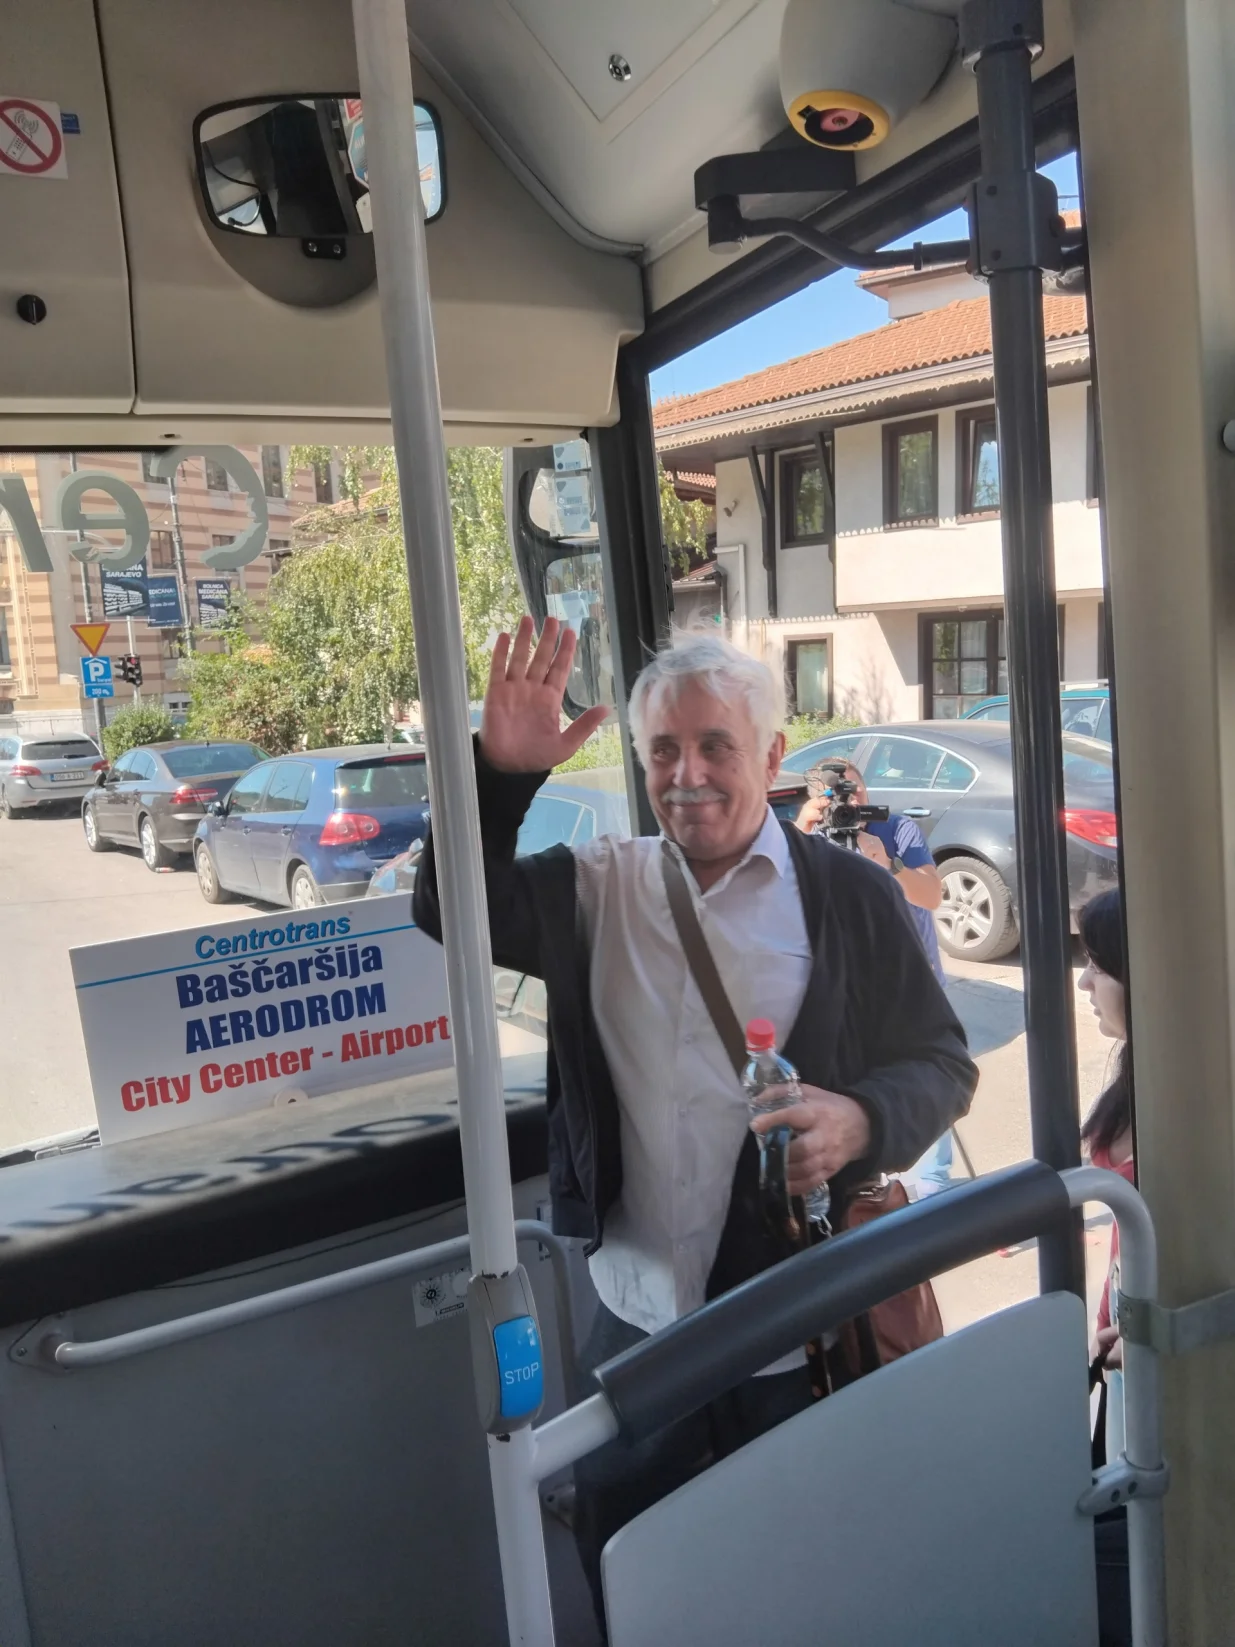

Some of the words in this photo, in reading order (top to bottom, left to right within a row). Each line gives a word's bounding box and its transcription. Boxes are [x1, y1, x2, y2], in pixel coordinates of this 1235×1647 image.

[89, 662, 104, 682] P
[195, 915, 351, 960] Centrotrans
[175, 942, 383, 1009] Baščaršija
[186, 982, 387, 1054] AERODROM
[121, 1071, 191, 1112] City
[199, 1046, 314, 1094] Center
[340, 1016, 451, 1062] Airport
[504, 1362, 539, 1385] STOP
